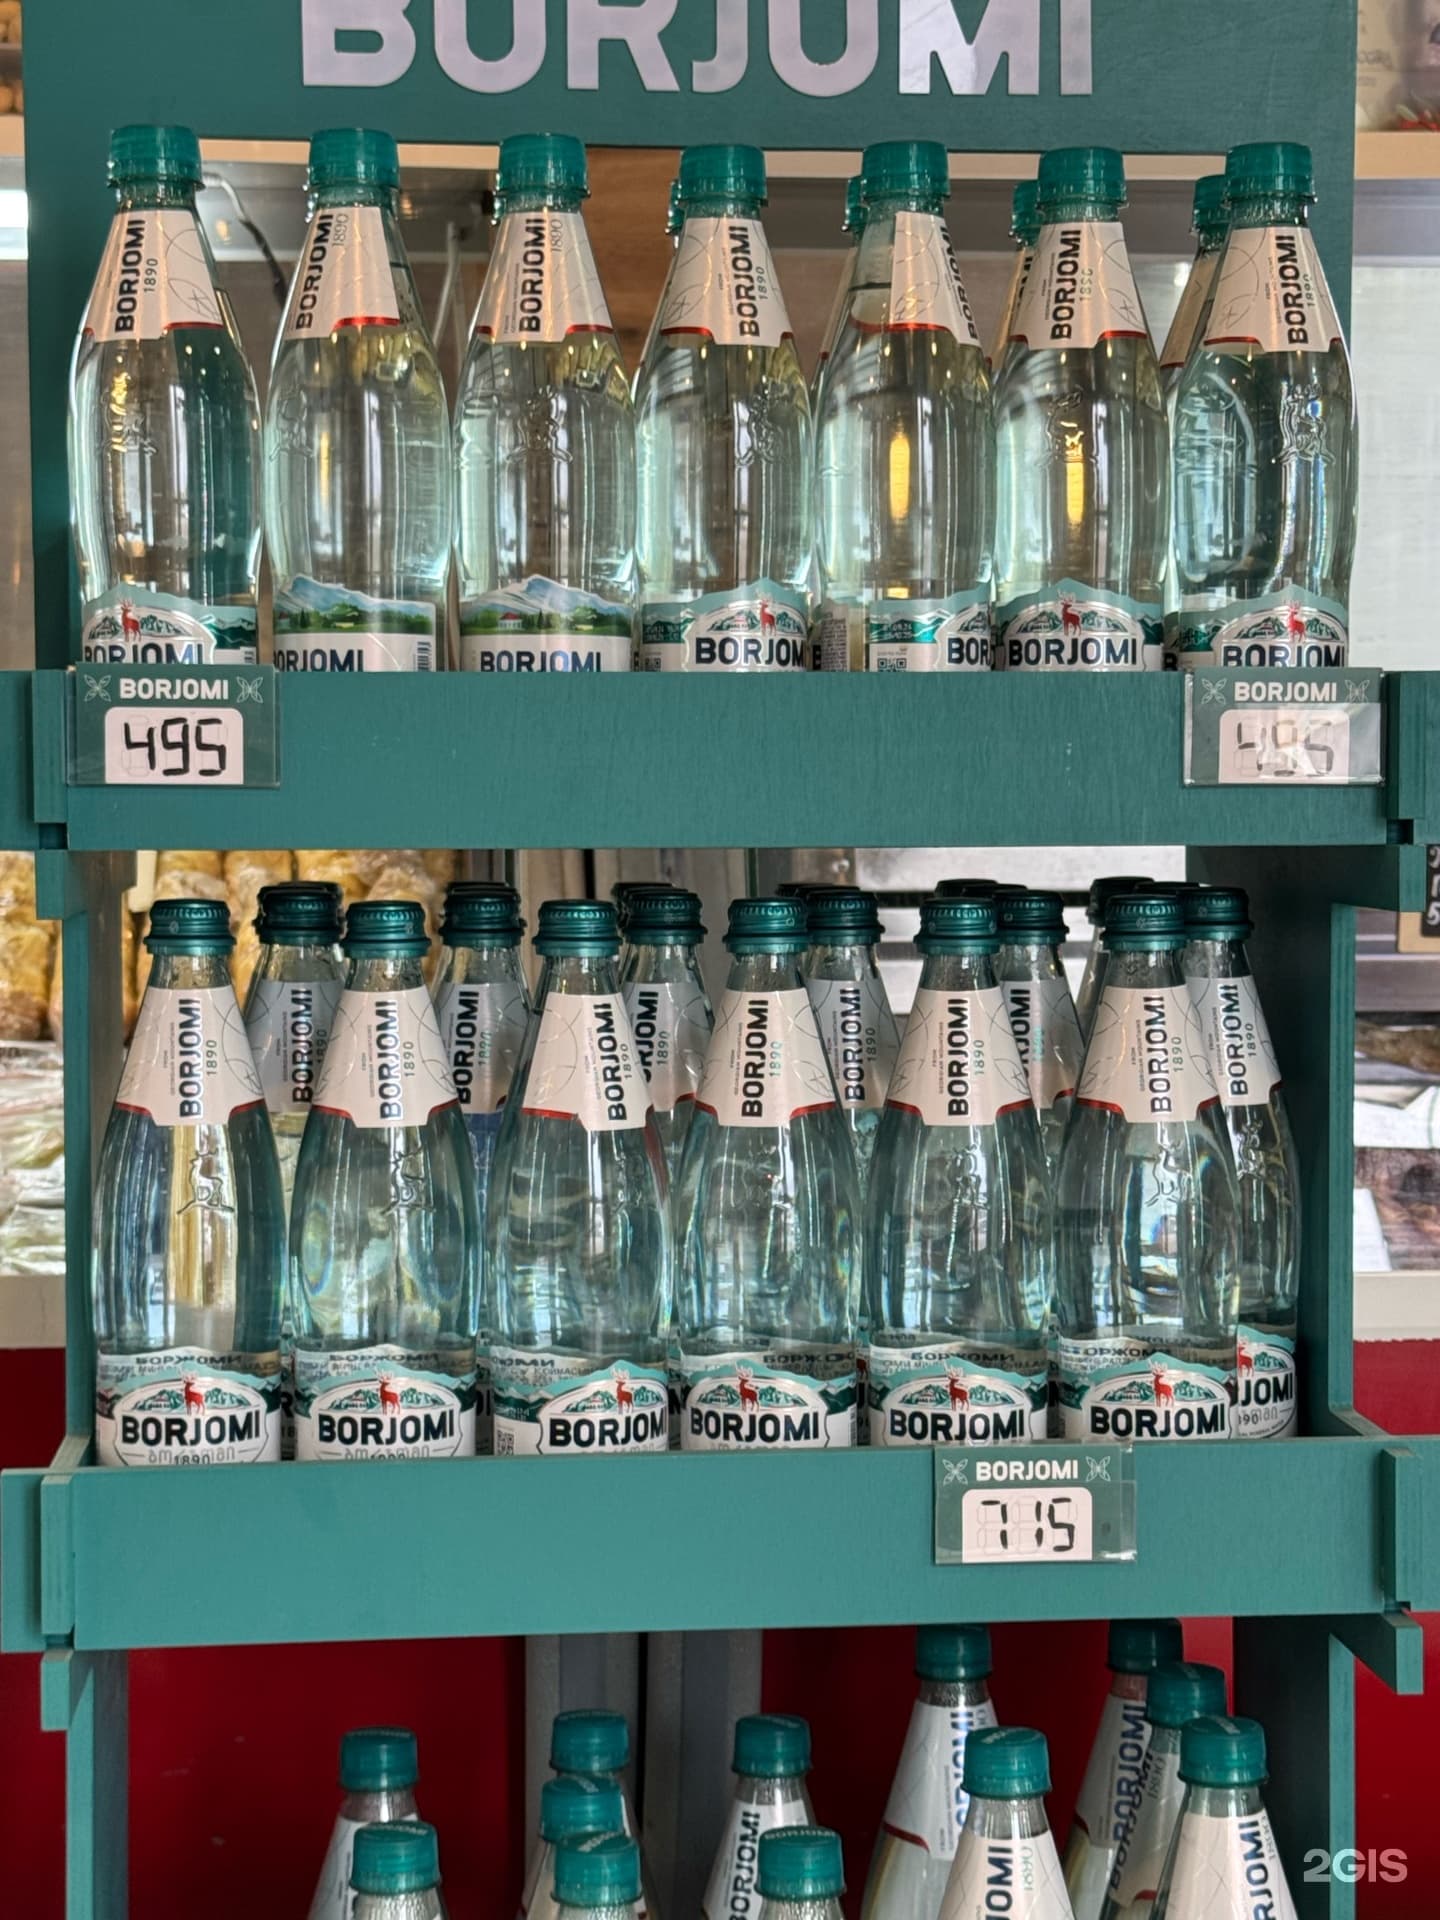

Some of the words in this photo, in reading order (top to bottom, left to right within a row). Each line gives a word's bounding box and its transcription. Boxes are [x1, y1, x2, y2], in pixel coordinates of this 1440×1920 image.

[301, 0, 1092, 97] BORJOMI
[115, 219, 145, 332] BORJOMI
[144, 258, 158, 293] 1890
[295, 214, 333, 330] BORJOMI
[519, 219, 546, 332] BORJOMI
[729, 226, 760, 337] BORJOMI
[1050, 230, 1081, 340] BORJOMI
[1275, 235, 1308, 344] BORJOMI
[480, 651, 601, 672] BORJOMI
[696, 637, 805, 667] BORJOM
[1009, 638, 1137, 666] BORJOMI
[119, 677, 229, 700] BORJOMI
[1234, 682, 1337, 702] BORJOMI
[124, 717, 227, 776] 495
[179, 998, 201, 1118] BORJOMI
[206, 1039, 217, 1076] 1890
[291, 989, 314, 1102] BORJOMI
[375, 1001, 402, 1119] BORJOMI
[403, 1041, 415, 1077] 1890
[452, 991, 479, 1104] BORJOMI
[593, 1003, 627, 1120] BORJOMI
[620, 1043, 632, 1080] 1890
[742, 1000, 769, 1117] BORJOMI
[769, 1041, 782, 1077] 1890
[840, 988, 866, 1101] BORJOMI
[947, 998, 969, 1116] BORJOMI
[973, 1039, 984, 1076] 1890
[1143, 996, 1171, 1112] BORJOMI
[1171, 1036, 1183, 1073] 1890
[1219, 984, 1248, 1096] BORJOMI
[1245, 1023, 1256, 1057] 1890
[1237, 1372, 1293, 1407] JOMI
[122, 1410, 260, 1446] BORJOMI
[318, 1408, 454, 1446] BORJOMI
[690, 1407, 819, 1443] BORJOMI
[890, 1408, 1024, 1441] BORJOMI
[1090, 1403, 1224, 1438] BORJOMI
[975, 1459, 1079, 1481] BORJOMI
[980, 1497, 1075, 1552] 715
[1238, 1820, 1275, 1920] RJOMI
